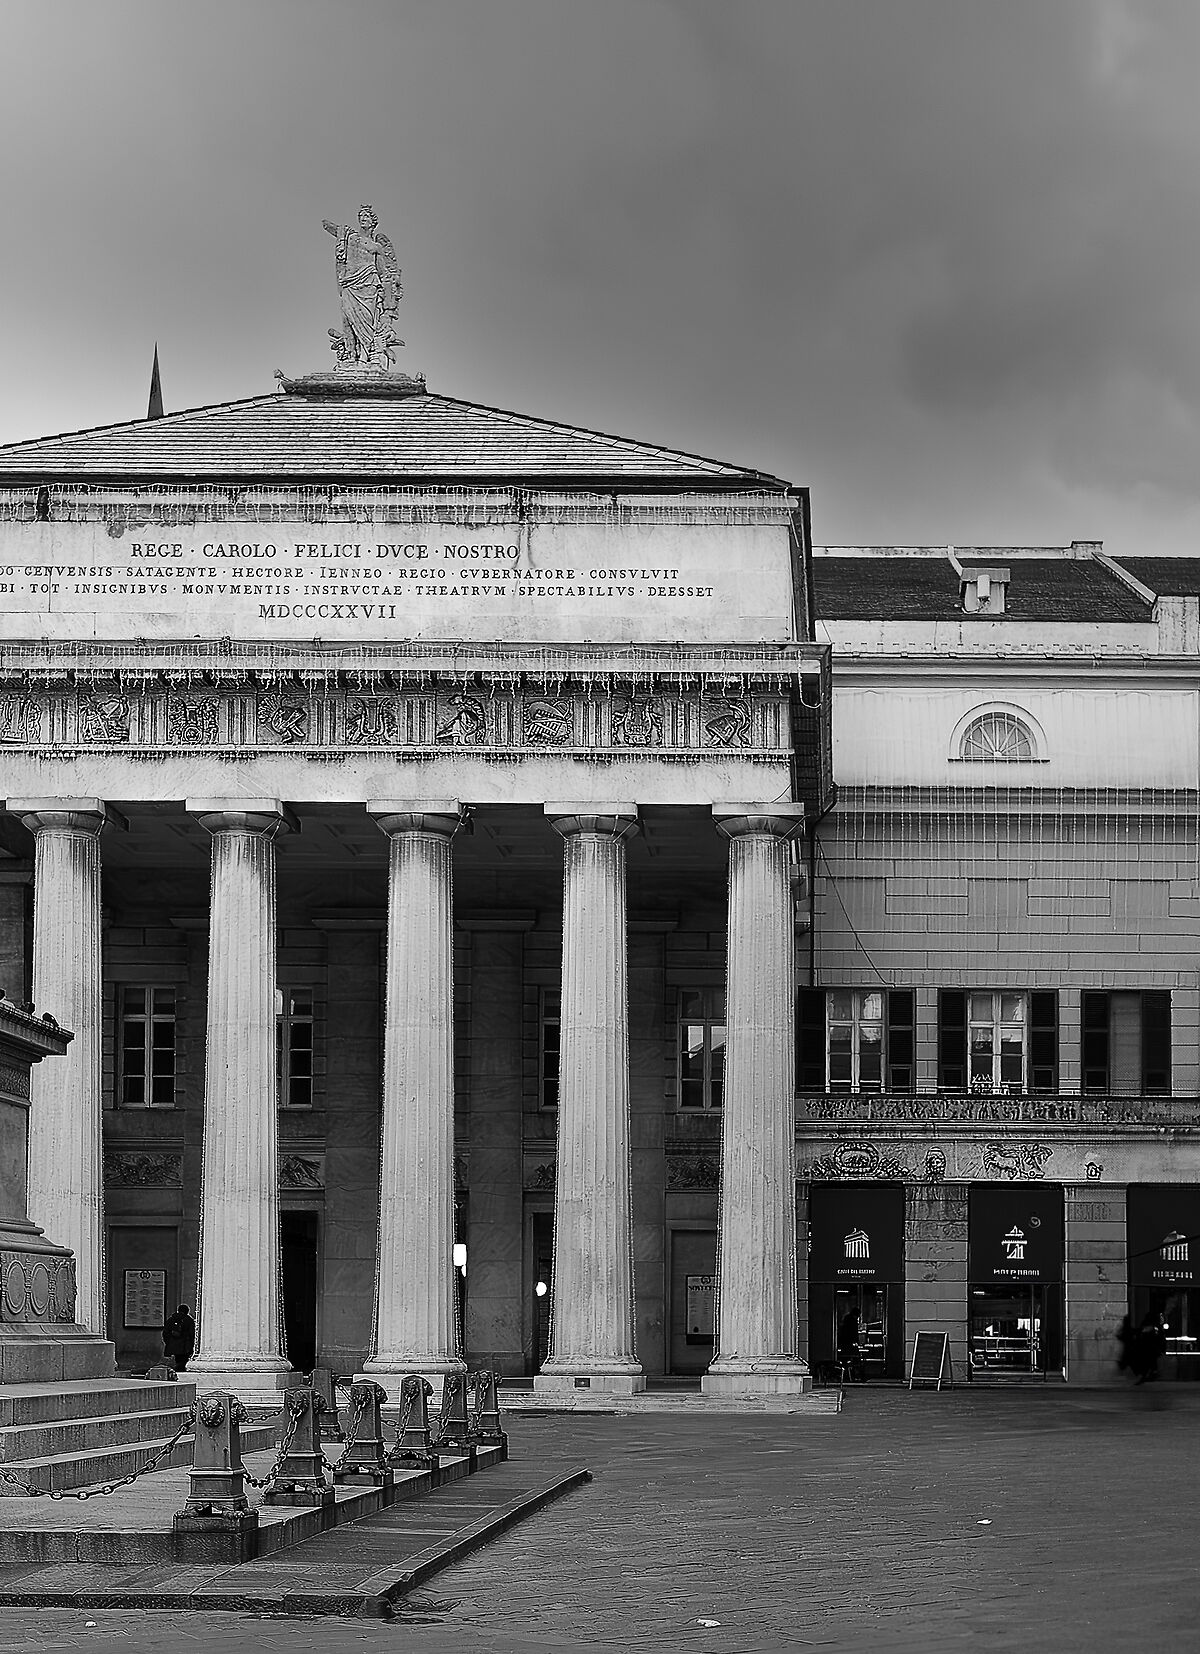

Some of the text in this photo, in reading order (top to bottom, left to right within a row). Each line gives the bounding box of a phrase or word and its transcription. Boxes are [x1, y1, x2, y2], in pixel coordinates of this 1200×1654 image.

[131, 543, 520, 559] REGE CAROLO FELICI DVCE NOSTRO
[24, 566, 114, 577] GENVENSIS
[126, 567, 217, 578] SATAGENTE
[231, 567, 304, 578] HECTORE
[319, 566, 382, 579] IENNEO
[399, 568, 446, 579] REGIO
[460, 568, 576, 580] GVBERNATORE
[589, 569, 679, 580] CONSVLVIT
[29, 583, 60, 594] TOT
[74, 584, 168, 594] INSIGNIBVS
[182, 584, 291, 595] MONVMENTIS
[303, 585, 403, 596] INSTRVCTAE
[415, 586, 507, 596] THEATRVM
[518, 586, 636, 597] SPECTABILIVS
[647, 587, 714, 597] DEESSET
[258, 604, 397, 619] MDCCCXXVII
